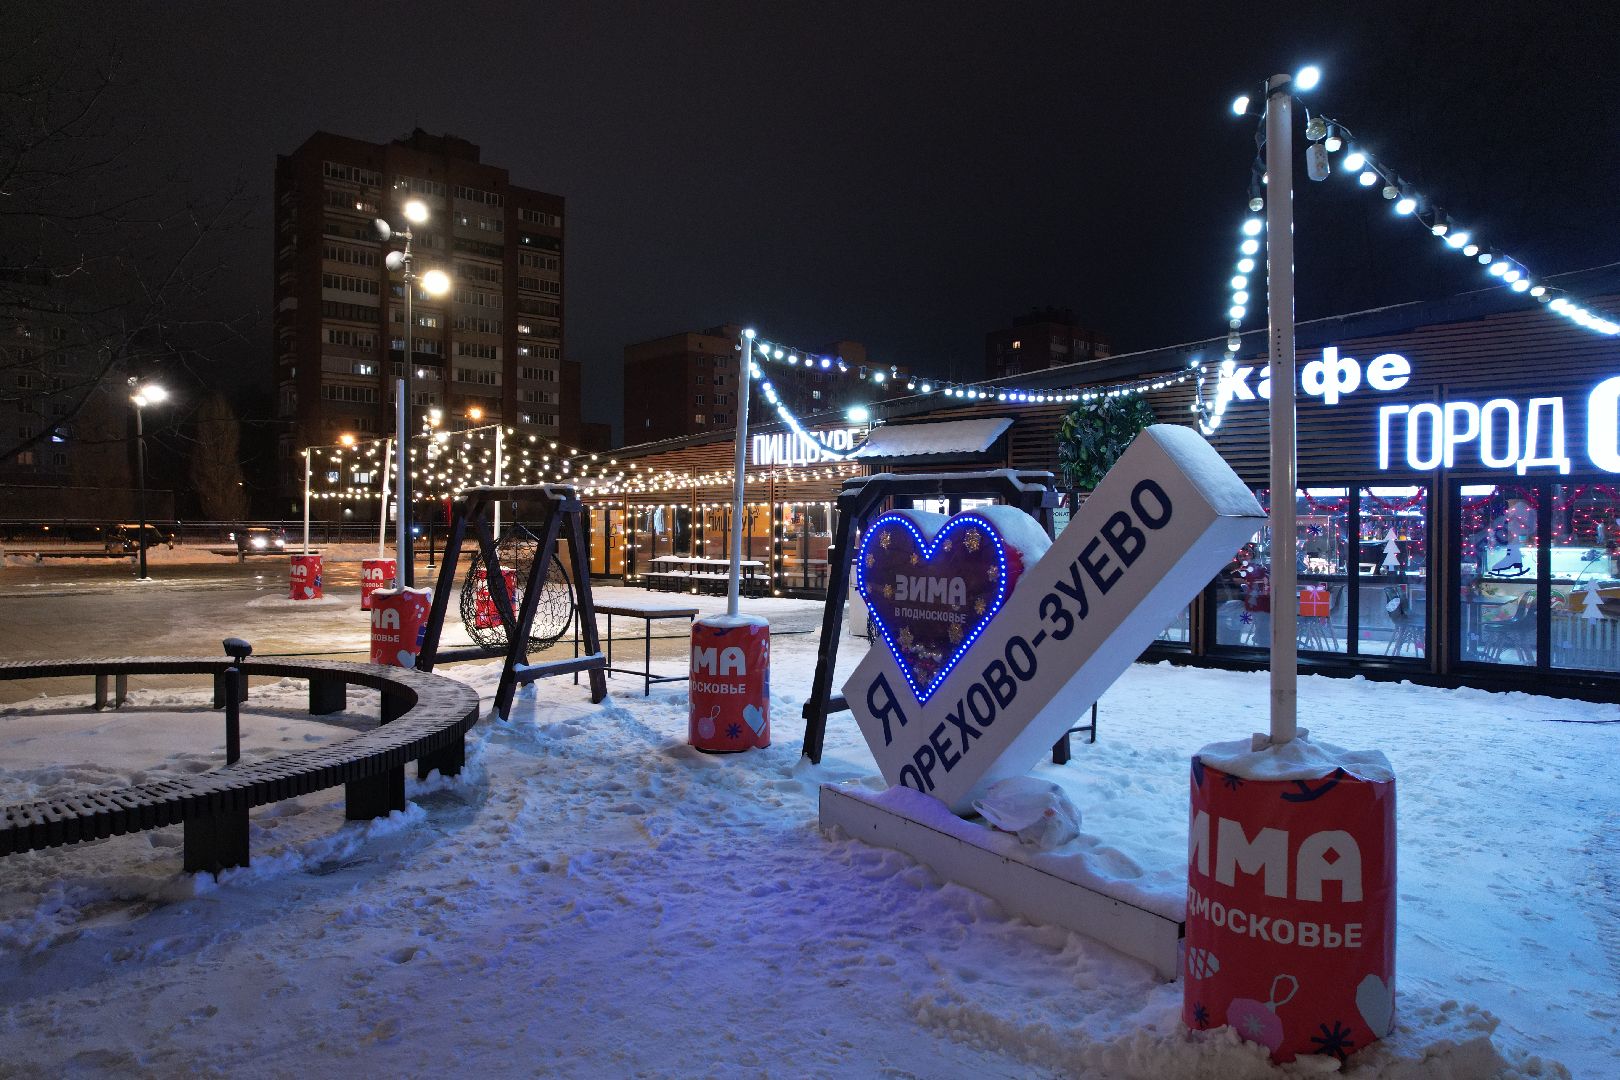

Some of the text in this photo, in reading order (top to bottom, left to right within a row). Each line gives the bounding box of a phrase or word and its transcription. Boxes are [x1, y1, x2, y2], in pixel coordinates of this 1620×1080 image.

[1379, 396, 1570, 476] ГОРОД
[894, 607, 967, 624] В ПОДМОСКОВЬЕ
[895, 574, 967, 606] ЗИМА
[693, 645, 747, 676] МА
[899, 478, 1174, 794] ОРЕХОВО-ЗУЕВО
[866, 671, 908, 748] Я
